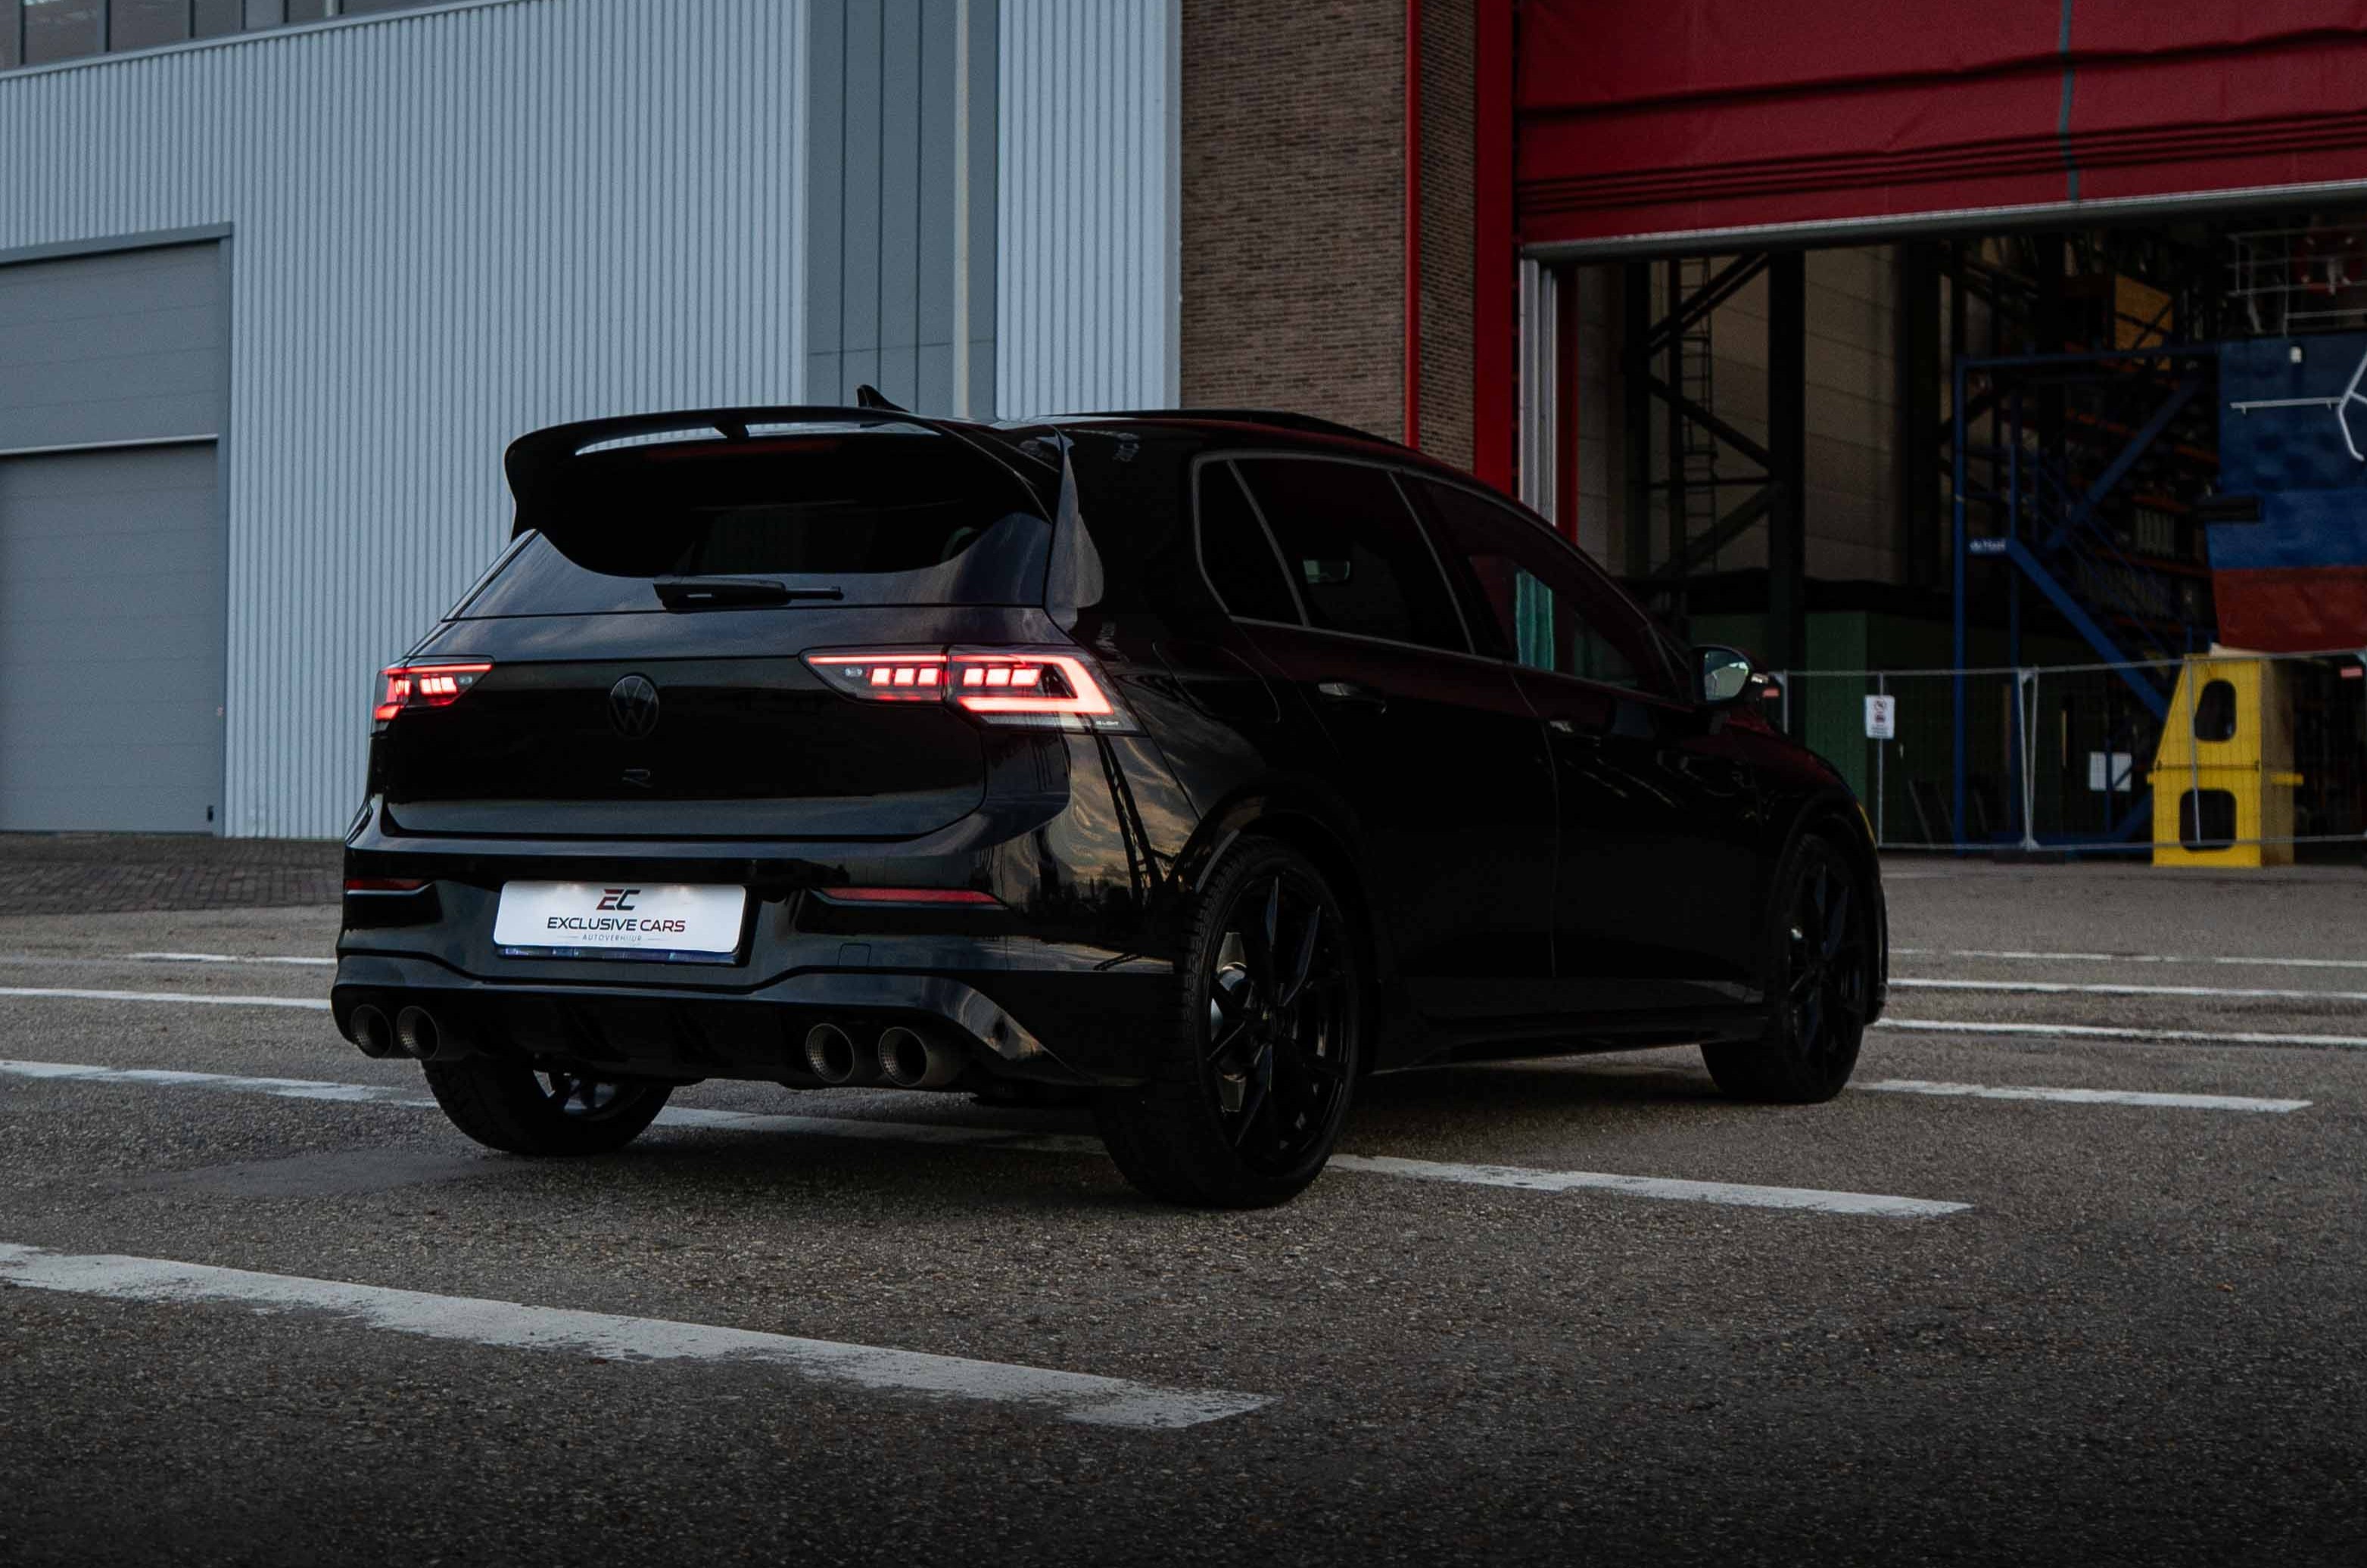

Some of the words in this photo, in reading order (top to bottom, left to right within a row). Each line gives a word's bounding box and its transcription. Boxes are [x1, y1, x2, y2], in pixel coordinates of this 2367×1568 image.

[621, 767, 655, 789] R
[596, 888, 641, 911] EC
[547, 917, 637, 931] EXCLUSIVE
[640, 919, 686, 932] CARS
